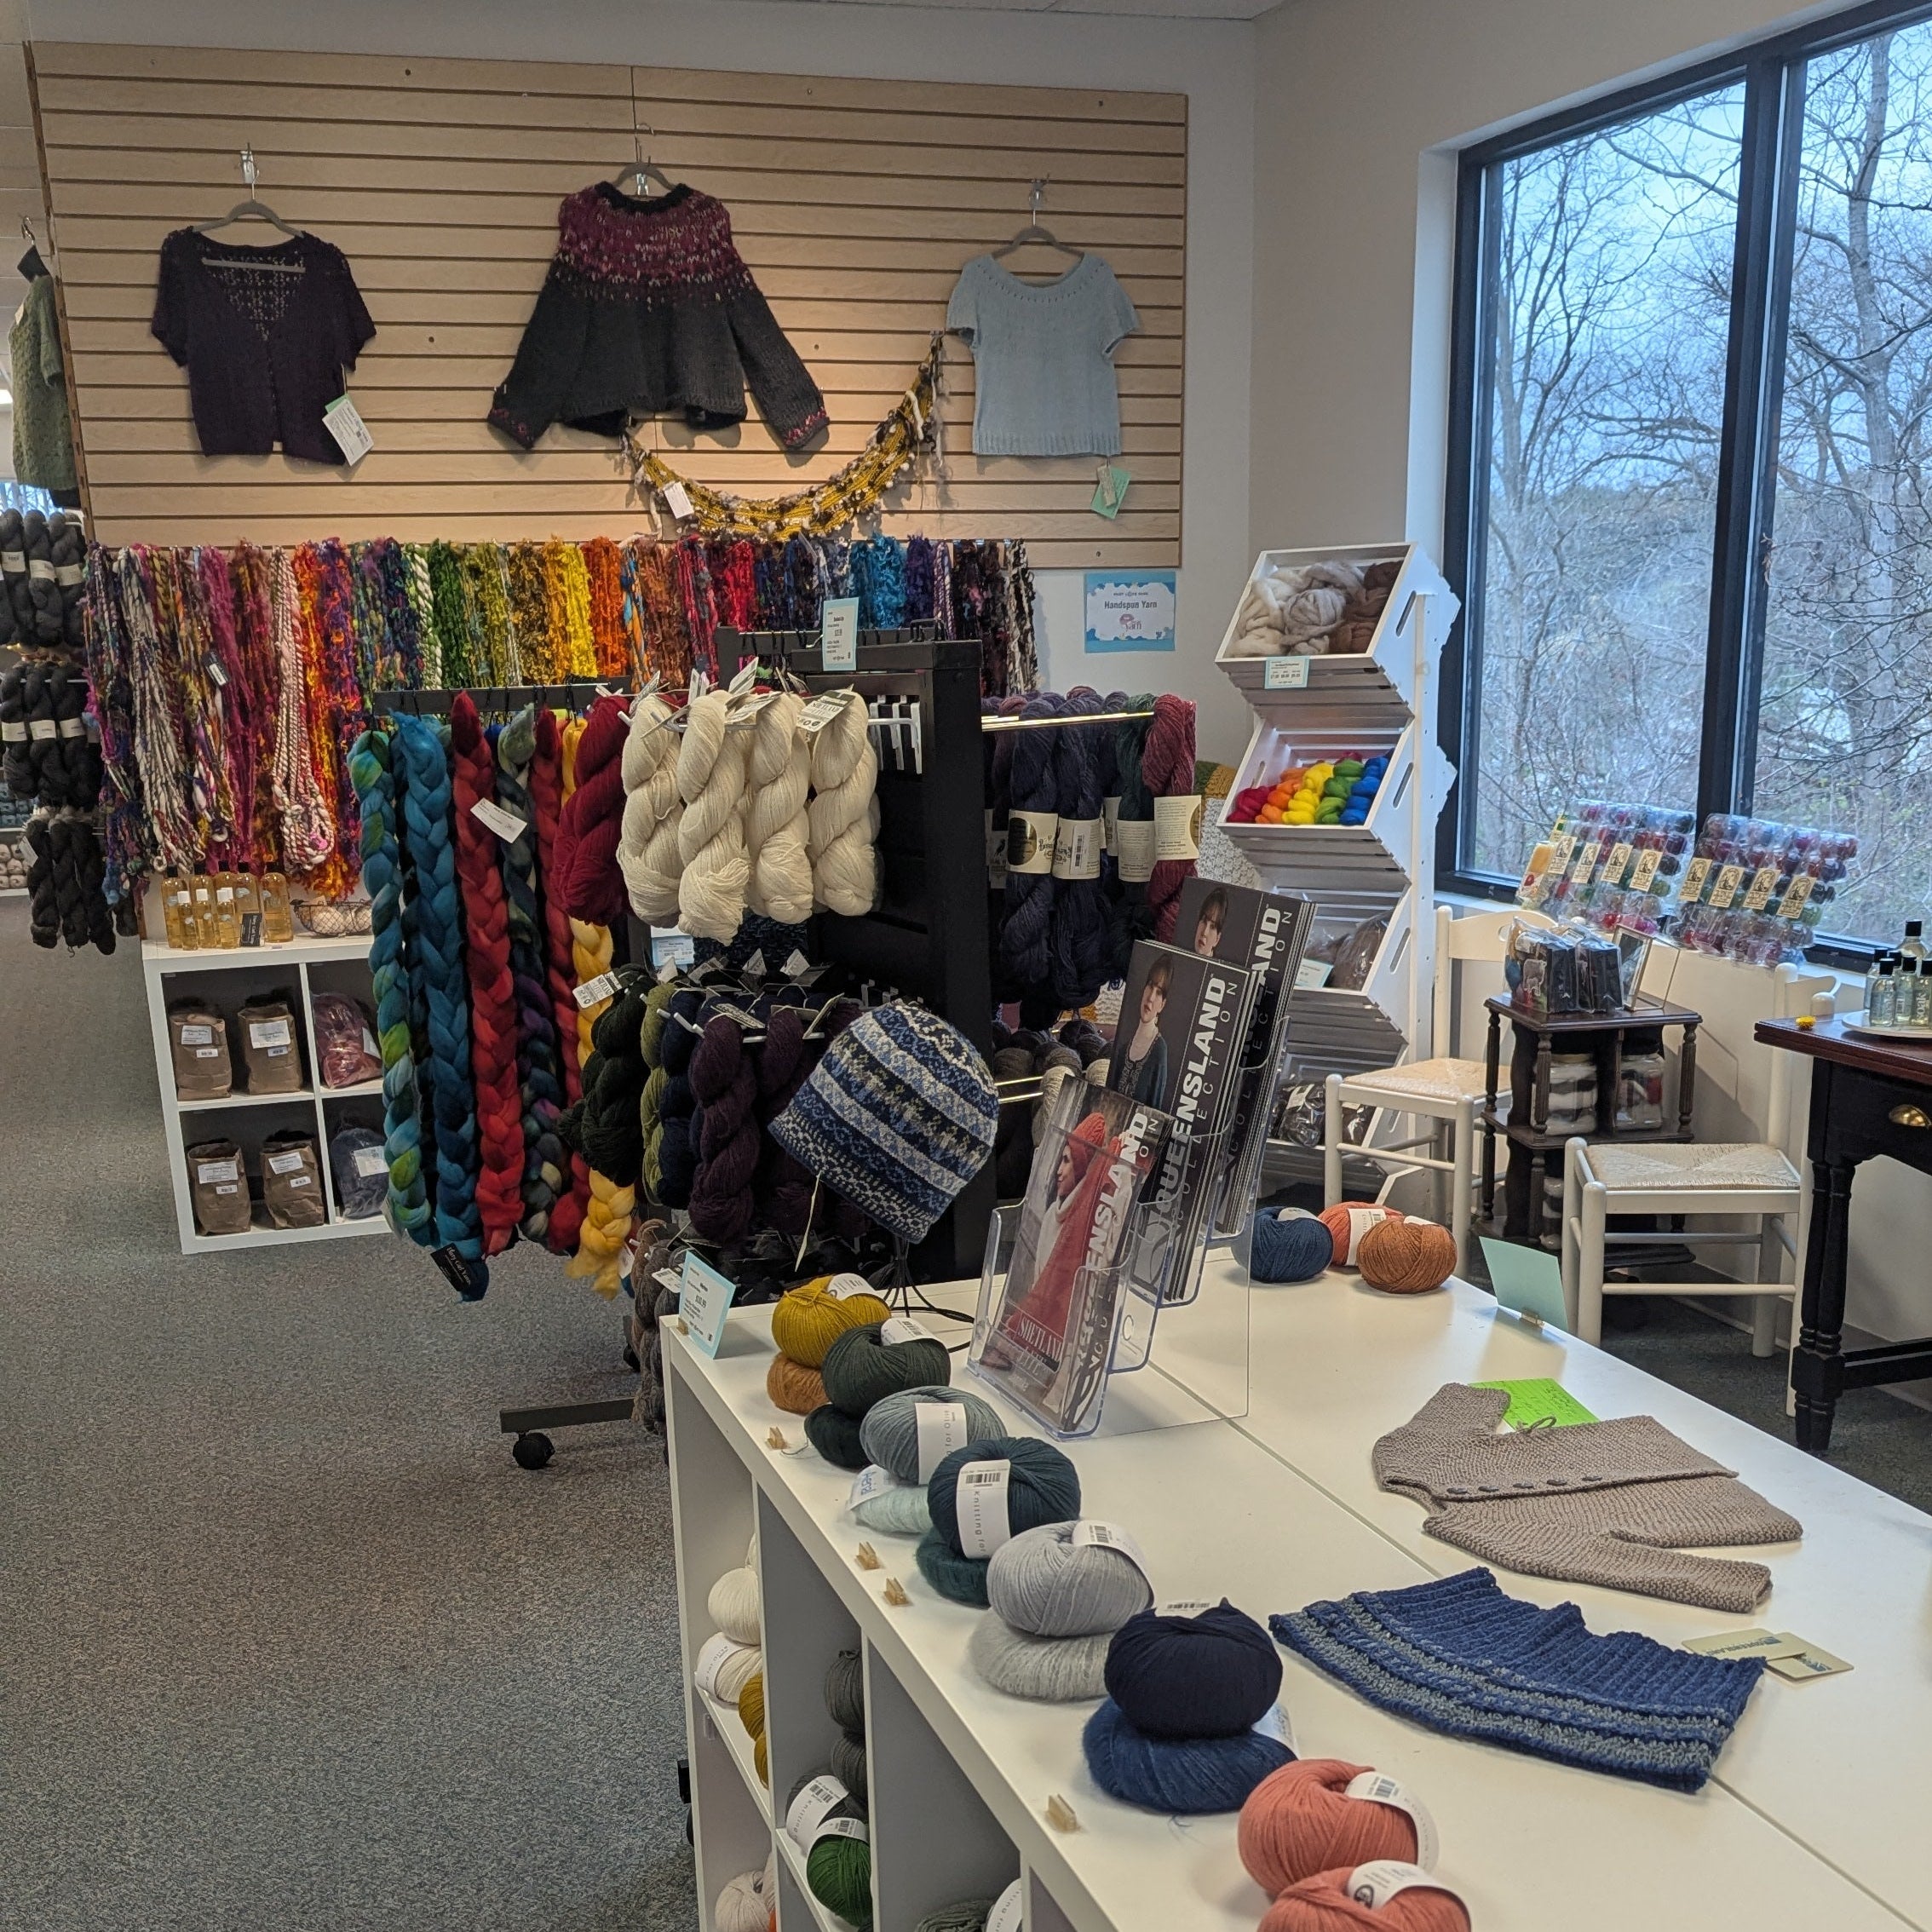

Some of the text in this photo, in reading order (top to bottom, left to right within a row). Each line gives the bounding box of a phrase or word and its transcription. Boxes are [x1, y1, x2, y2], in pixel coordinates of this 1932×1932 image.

[1104, 601, 1139, 610] Handspun
[1156, 977, 1226, 1215] QUEENSLAND
[1176, 981, 1238, 1221] COLLECTION
[974, 1491, 982, 1536] Knitting
